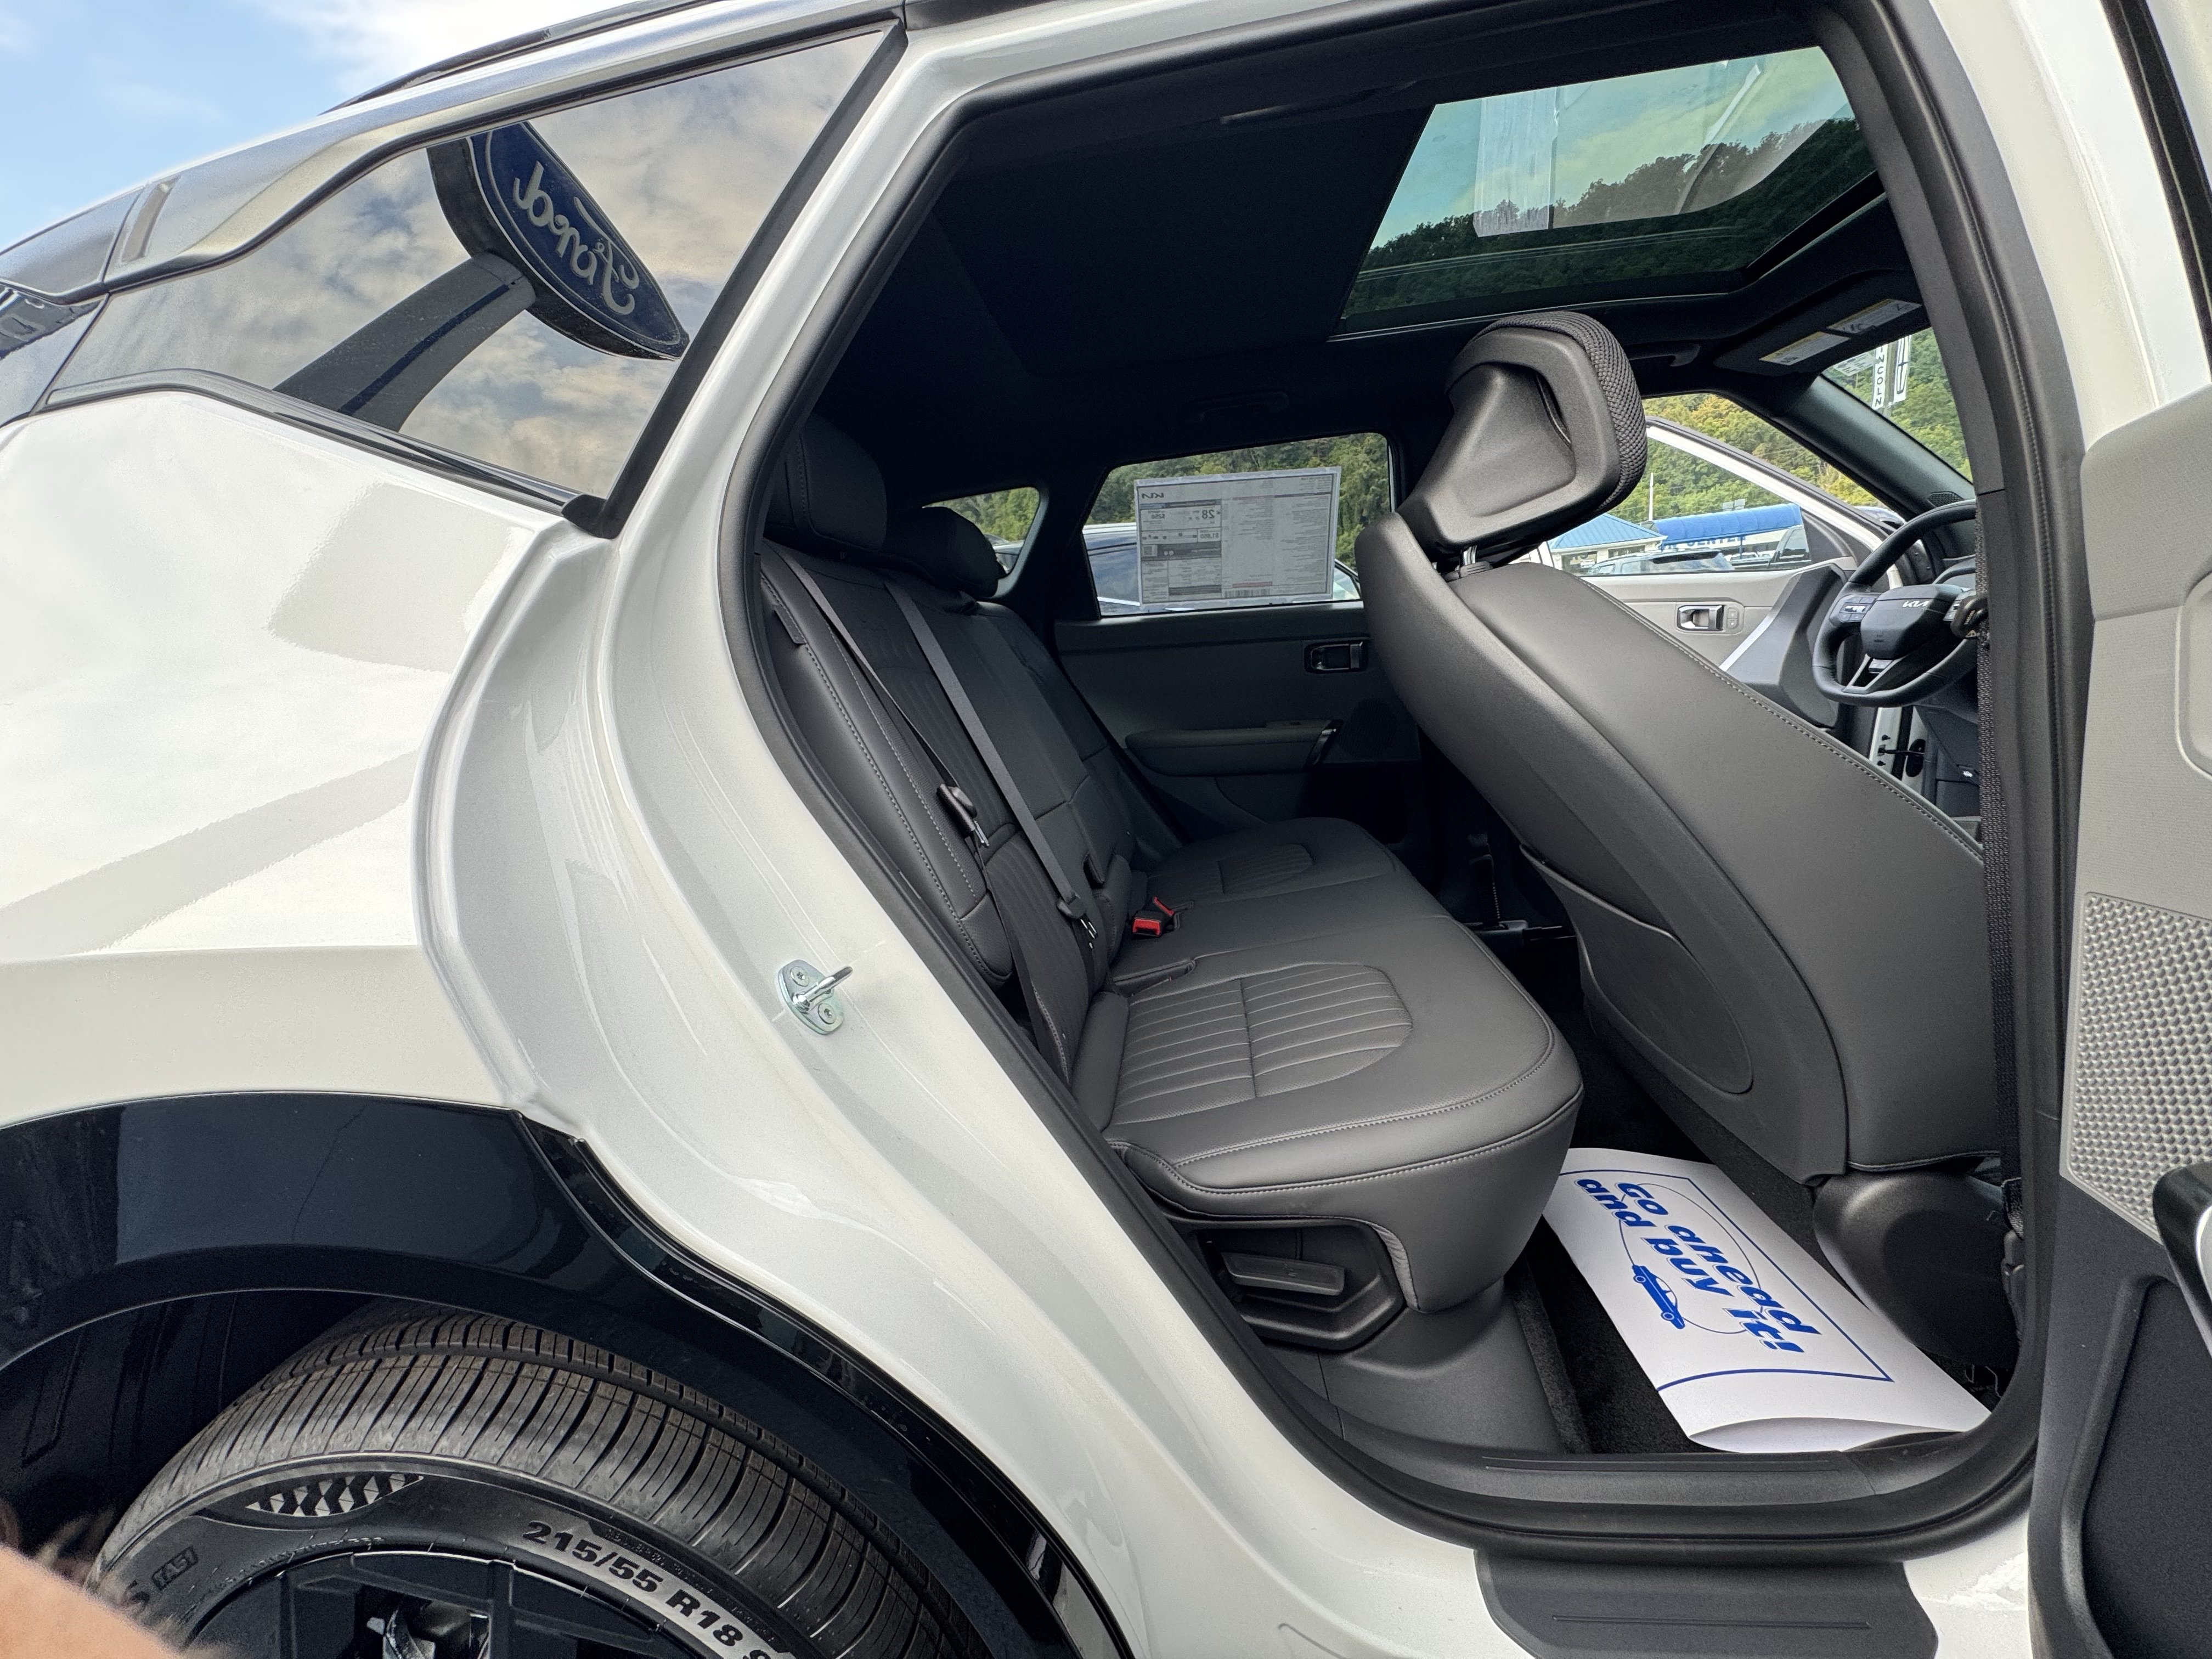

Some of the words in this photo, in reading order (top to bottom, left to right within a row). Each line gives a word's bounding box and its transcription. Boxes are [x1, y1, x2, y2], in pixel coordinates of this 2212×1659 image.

[1574, 1178, 1657, 1227] and
[1640, 1237, 1735, 1297] buy
[1722, 1307, 1804, 1353] it!
[1615, 1182, 1668, 1215] Go
[1664, 1224, 1821, 1335] ahead
[522, 1521, 663, 1592] 215/55
[665, 1589, 743, 1646] R18
